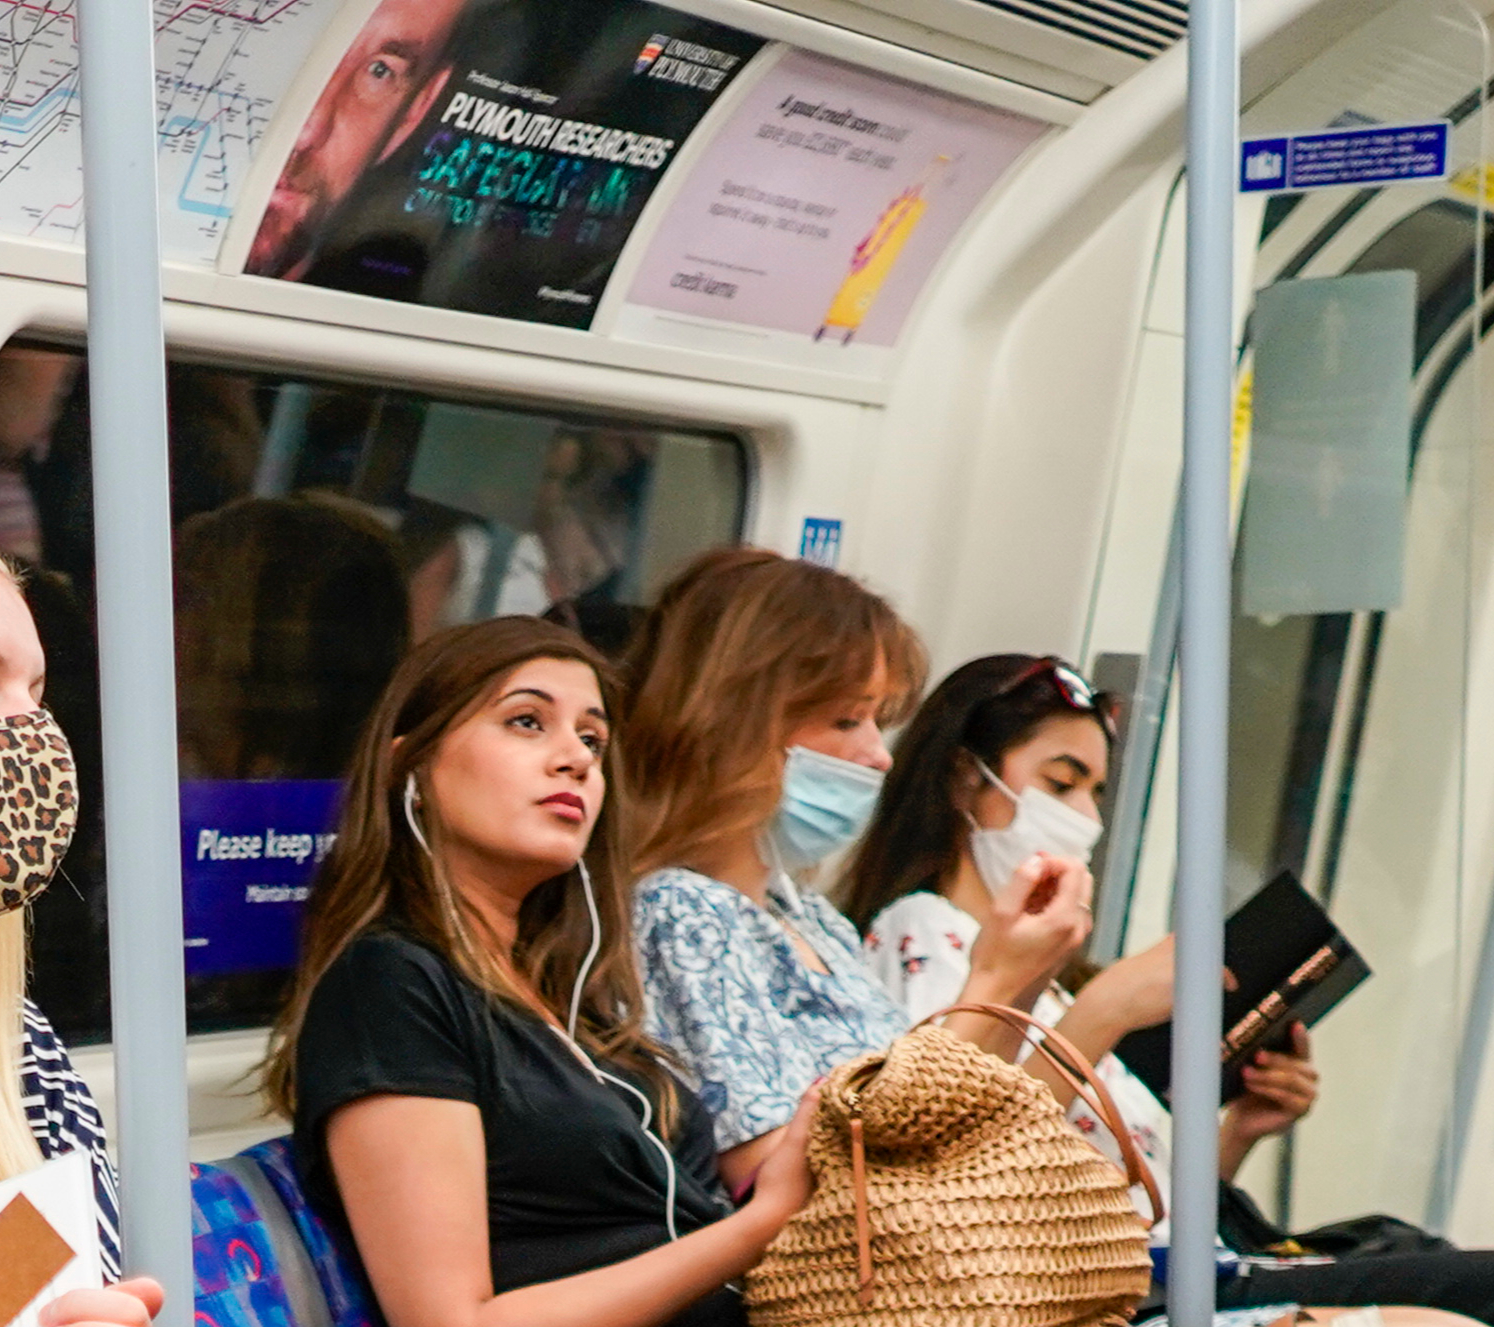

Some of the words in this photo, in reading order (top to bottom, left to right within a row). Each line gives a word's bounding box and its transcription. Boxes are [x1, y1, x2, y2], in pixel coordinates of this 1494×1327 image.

[440, 92, 562, 150] PLYMOUTH
[549, 119, 675, 169] RESEARCHERS
[196, 829, 262, 861] Please
[264, 827, 312, 865] keep
